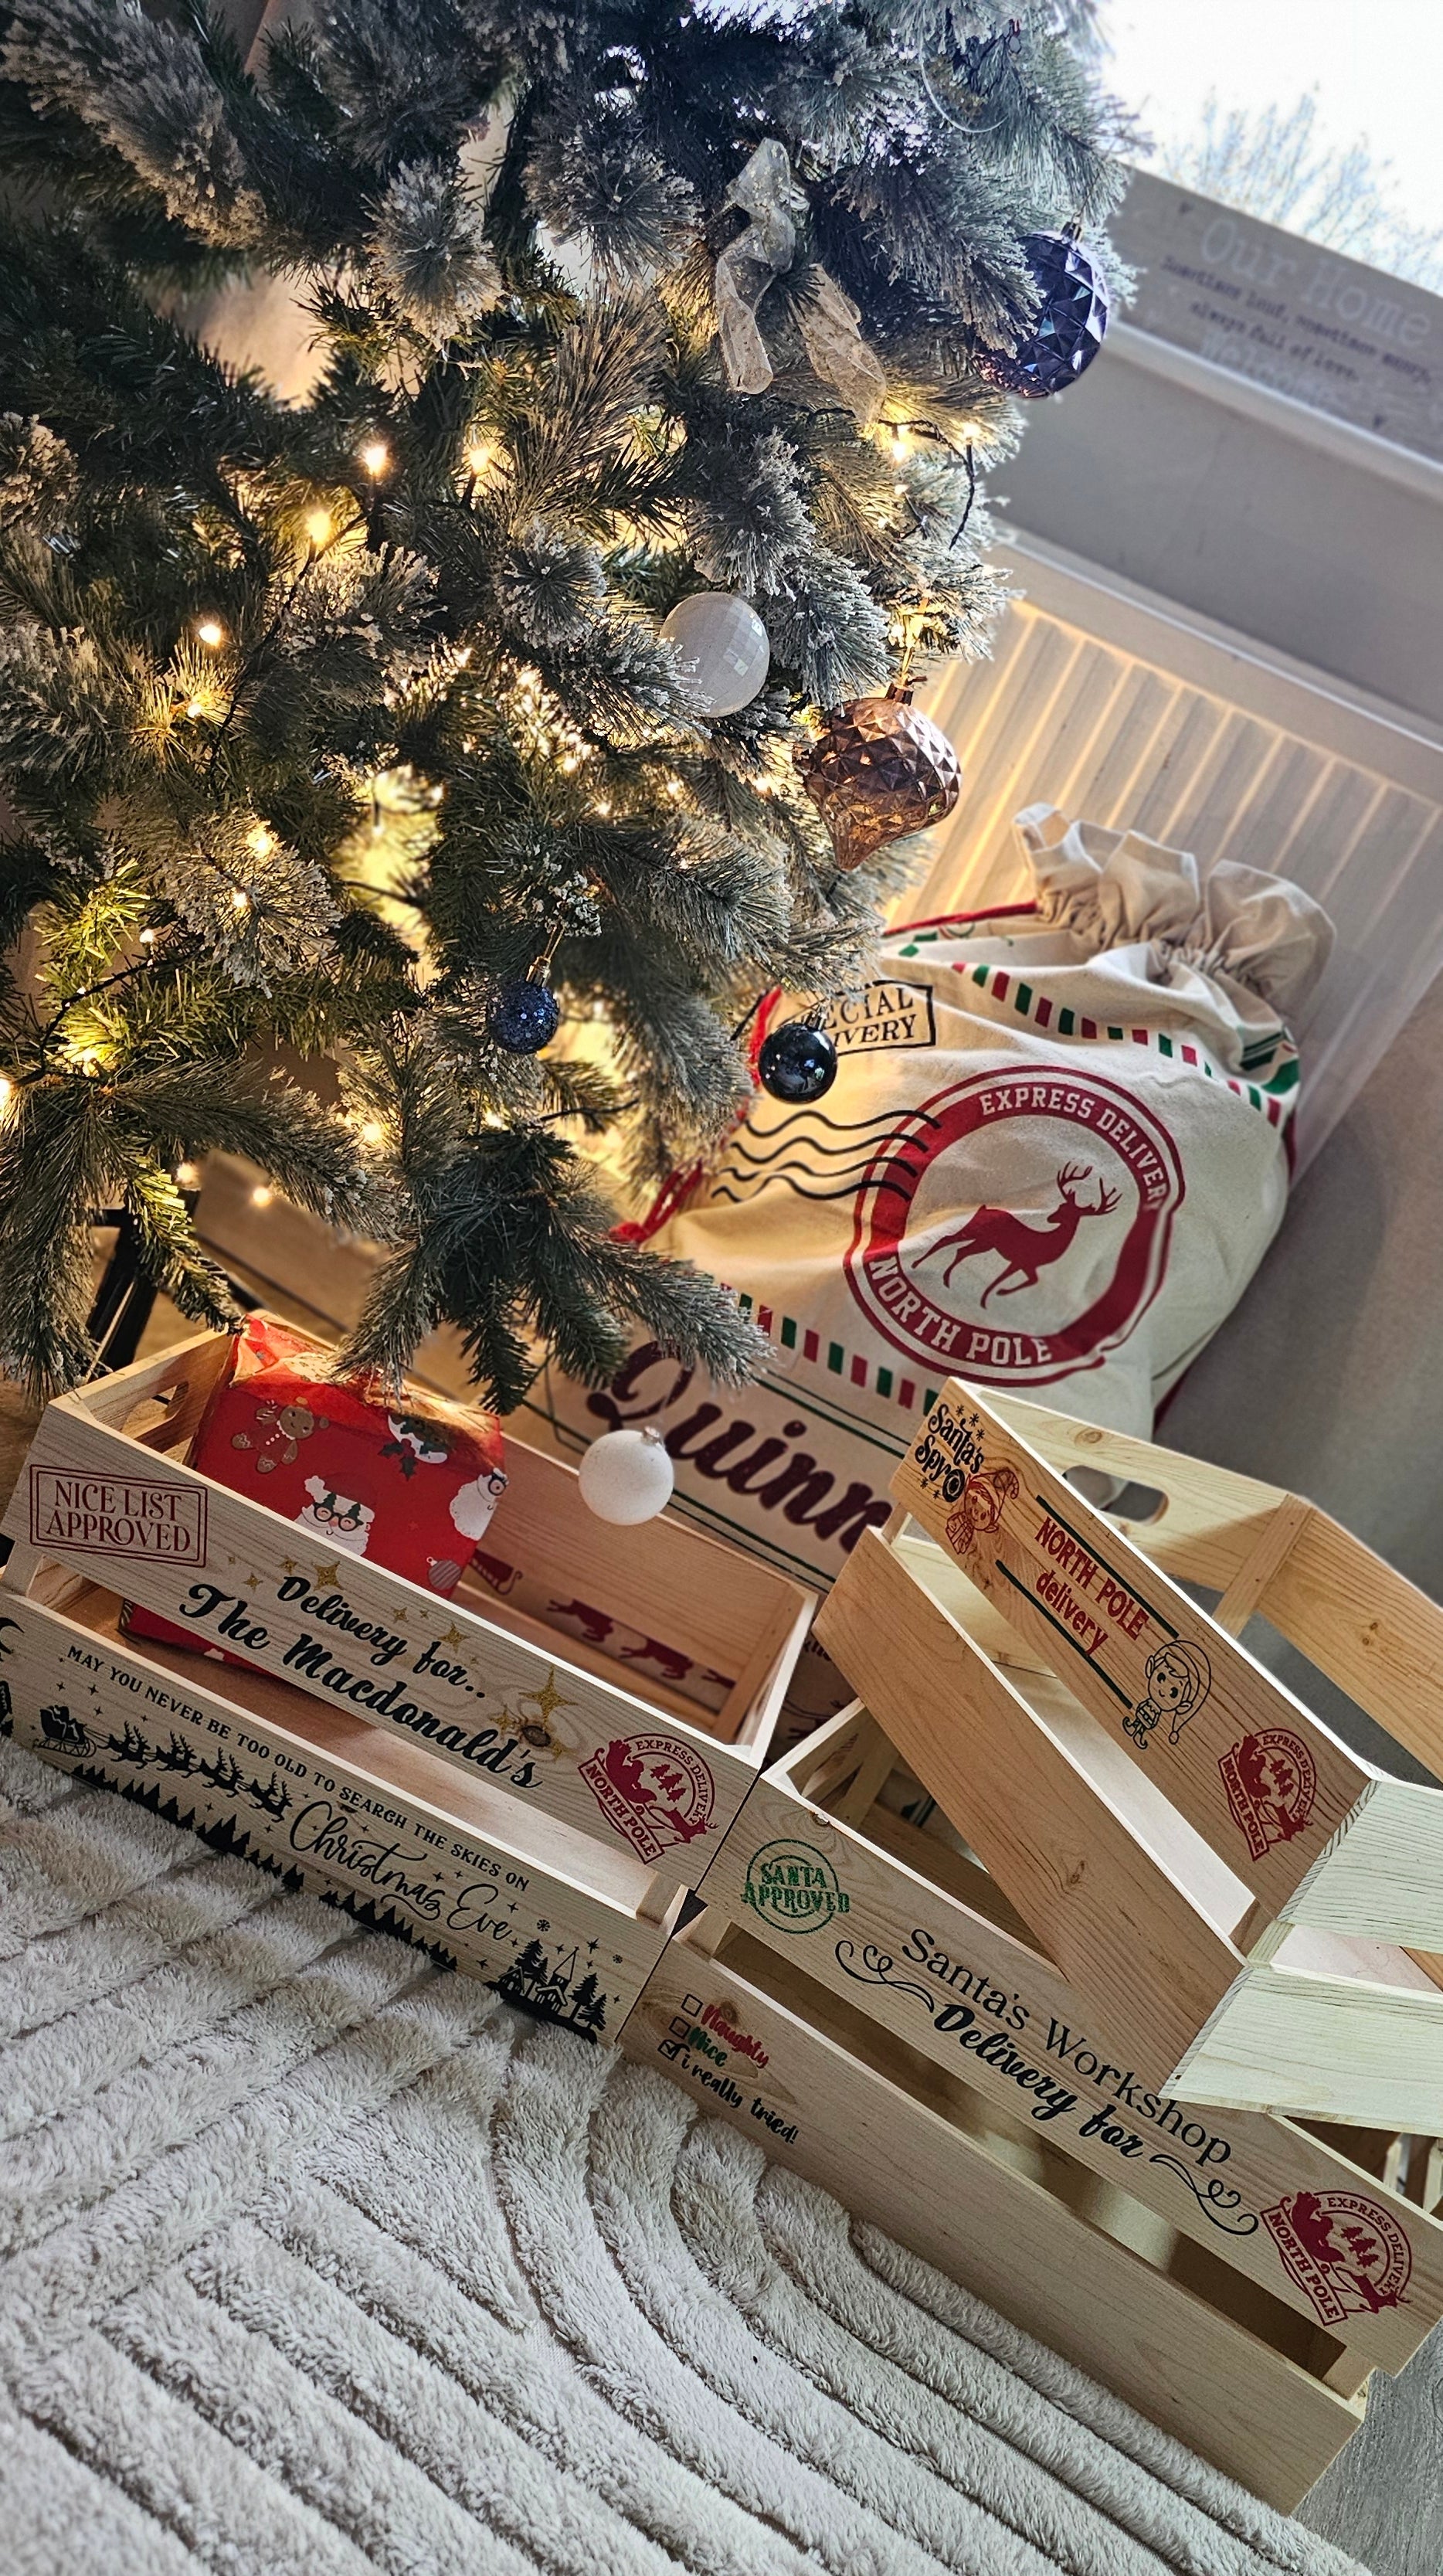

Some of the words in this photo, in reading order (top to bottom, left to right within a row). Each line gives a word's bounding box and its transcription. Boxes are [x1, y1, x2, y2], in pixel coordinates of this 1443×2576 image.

[1201, 219, 1297, 287] Our
[1302, 259, 1429, 345] Home
[980, 1086, 1095, 1119] EXPRESS
[868, 1257, 961, 1351] NORTH
[966, 1332, 1053, 1364] POLE
[928, 1404, 984, 1473] Santa's
[46, 1511, 191, 1552] APPROVED
[55, 1480, 114, 1512] NICE
[124, 1488, 182, 1521] LIST
[1035, 1516, 1098, 1590] NORTH
[1096, 1577, 1149, 1640] POLE
[1036, 1570, 1109, 1657] delivery
[277, 1576, 406, 1665] Delivery
[413, 1641, 486, 1698] for..
[179, 1584, 270, 1649] The
[284, 1633, 543, 1788] Macdonald's
[67, 1646, 104, 1672] MAY
[109, 1667, 143, 1693] YOU
[144, 1686, 203, 1726] NEVER
[207, 1719, 231, 1740] BE
[236, 1733, 270, 1759] TOO
[275, 1753, 307, 1778] OLD
[314, 1772, 335, 1792] TO
[340, 1787, 408, 1829] SEARCH
[414, 1823, 447, 1849] THE
[451, 1844, 501, 1876] SKIES
[506, 1871, 530, 1891] ON
[635, 1740, 692, 1765] EXPRESS
[1262, 1735, 1304, 1759] EXPRESS
[586, 1764, 630, 1818] NORTH
[623, 1816, 657, 1857] POLE
[1223, 1758, 1249, 1812] NORTH
[1244, 1814, 1265, 1853] POLE
[290, 1801, 441, 1921] Christmas
[447, 1883, 513, 1939] Eve
[741, 1881, 851, 1914] APPROVED
[760, 1864, 827, 1888] SANTA
[688, 2027, 728, 2067] Nice
[701, 2003, 769, 2068] Naughty
[902, 1929, 1030, 2031] Santa's
[1044, 2017, 1231, 2166] Workshop
[692, 2065, 743, 2108] really
[750, 2098, 799, 2144] tried!
[933, 2003, 1078, 2121] Delivery
[1080, 2104, 1143, 2158] for
[1326, 2197, 1391, 2232] EXPRESS
[1268, 2211, 1312, 2272] NORTH
[1305, 2272, 1339, 2318] POLE
